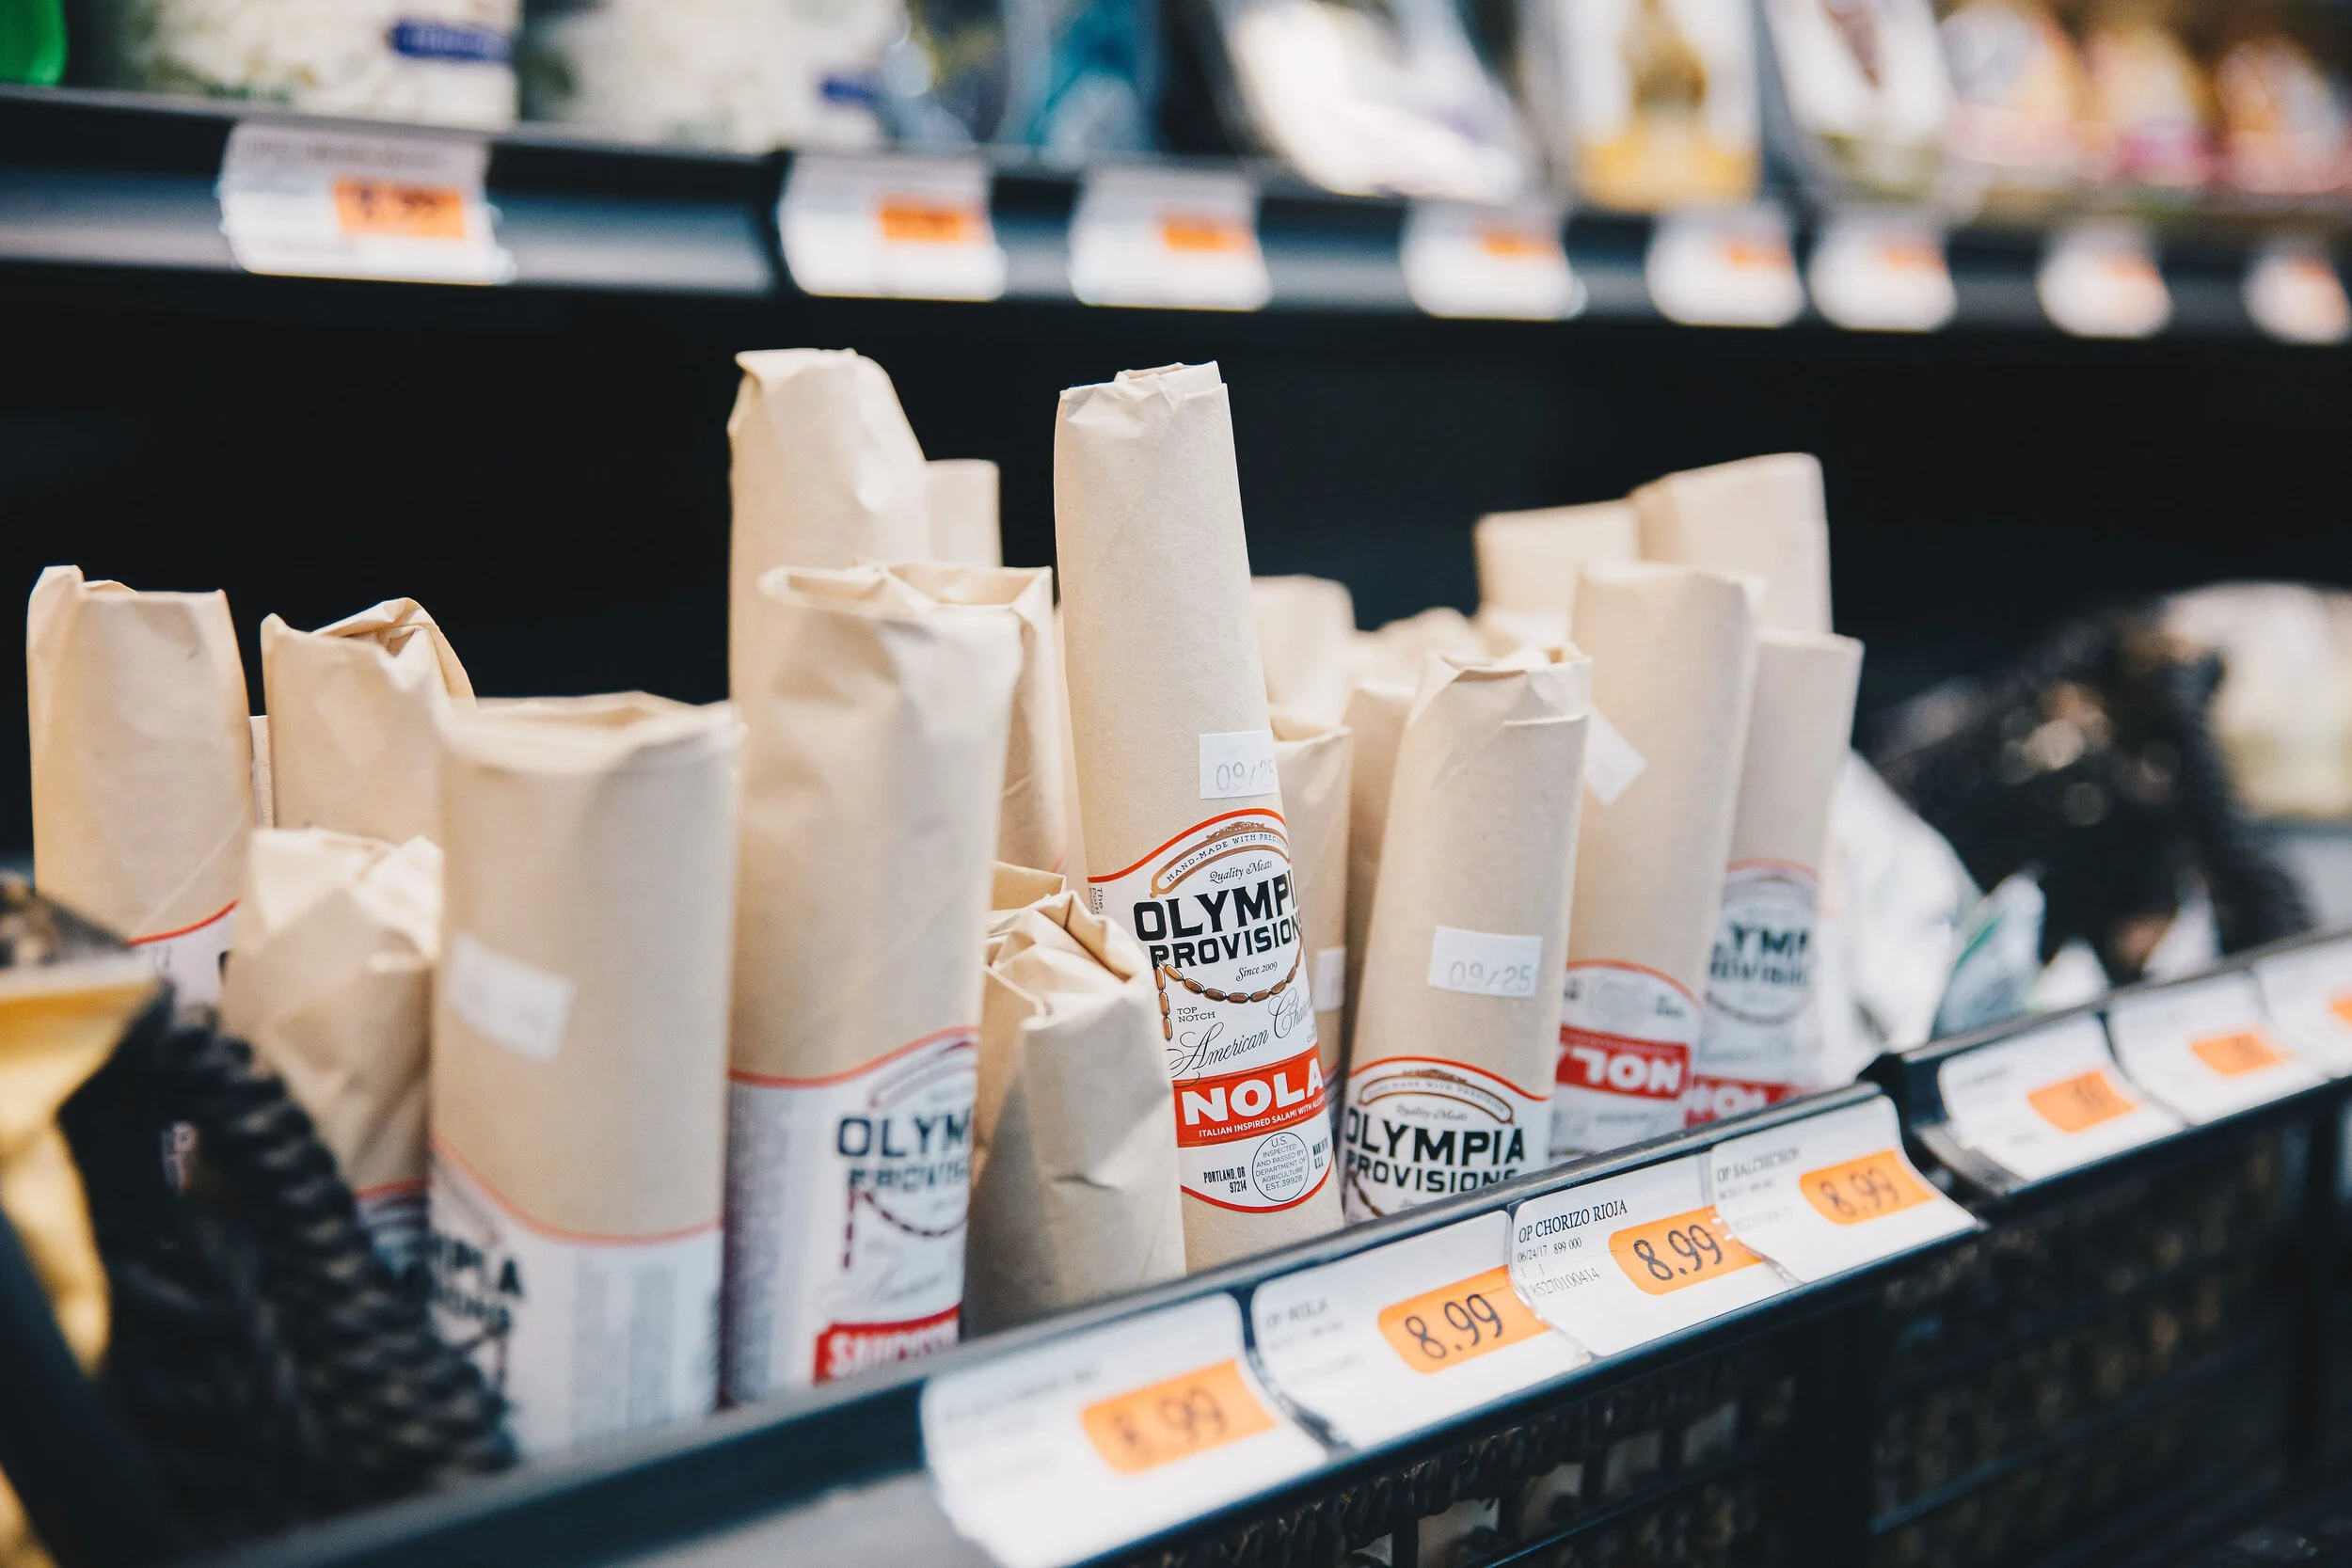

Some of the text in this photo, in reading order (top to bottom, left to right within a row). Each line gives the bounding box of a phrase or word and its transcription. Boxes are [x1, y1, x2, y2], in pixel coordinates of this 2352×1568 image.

[1216, 759, 1276, 791] 09/25
[1167, 841, 1229, 882] HAND-MADE
[1232, 833, 1256, 845] WITH
[1210, 859, 1273, 884] Quality Meats
[1133, 870, 1297, 942] OLYMPI
[1235, 961, 1279, 982] Since 2009
[1450, 960, 1532, 992] 09/25
[1177, 1006, 1198, 1015] TOP
[1178, 1011, 1216, 1023] NOTCH
[1167, 1022, 1269, 1079] American
[1558, 1045, 1682, 1093] NOL
[1182, 1055, 1325, 1126] NOLA
[1199, 1126, 1233, 1138] ITALIAN
[1234, 1117, 1271, 1132] INSPIRED
[1272, 1110, 1297, 1124] SALAMI
[1298, 1102, 1312, 1115] WITH
[1263, 1143, 1297, 1158] INSPECTED
[1270, 1135, 1288, 1148] U.S.
[1345, 1106, 1525, 1167] OLYMPIA
[1255, 1156, 1307, 1178] DEPARTMENT OF
[1256, 1148, 1304, 1168] AND PASSED BY
[1229, 1179, 1248, 1194] 97214
[1262, 1165, 1305, 1184] AGRICULTURE
[1820, 1167, 1899, 1217] 8.99
[1518, 1199, 1628, 1243] OP CHORIZO RIOJA
[1518, 1237, 1582, 1263] 06/24/17 899 000
[1632, 1224, 1723, 1282] 8.99
[1405, 1292, 1503, 1359] 8.99
